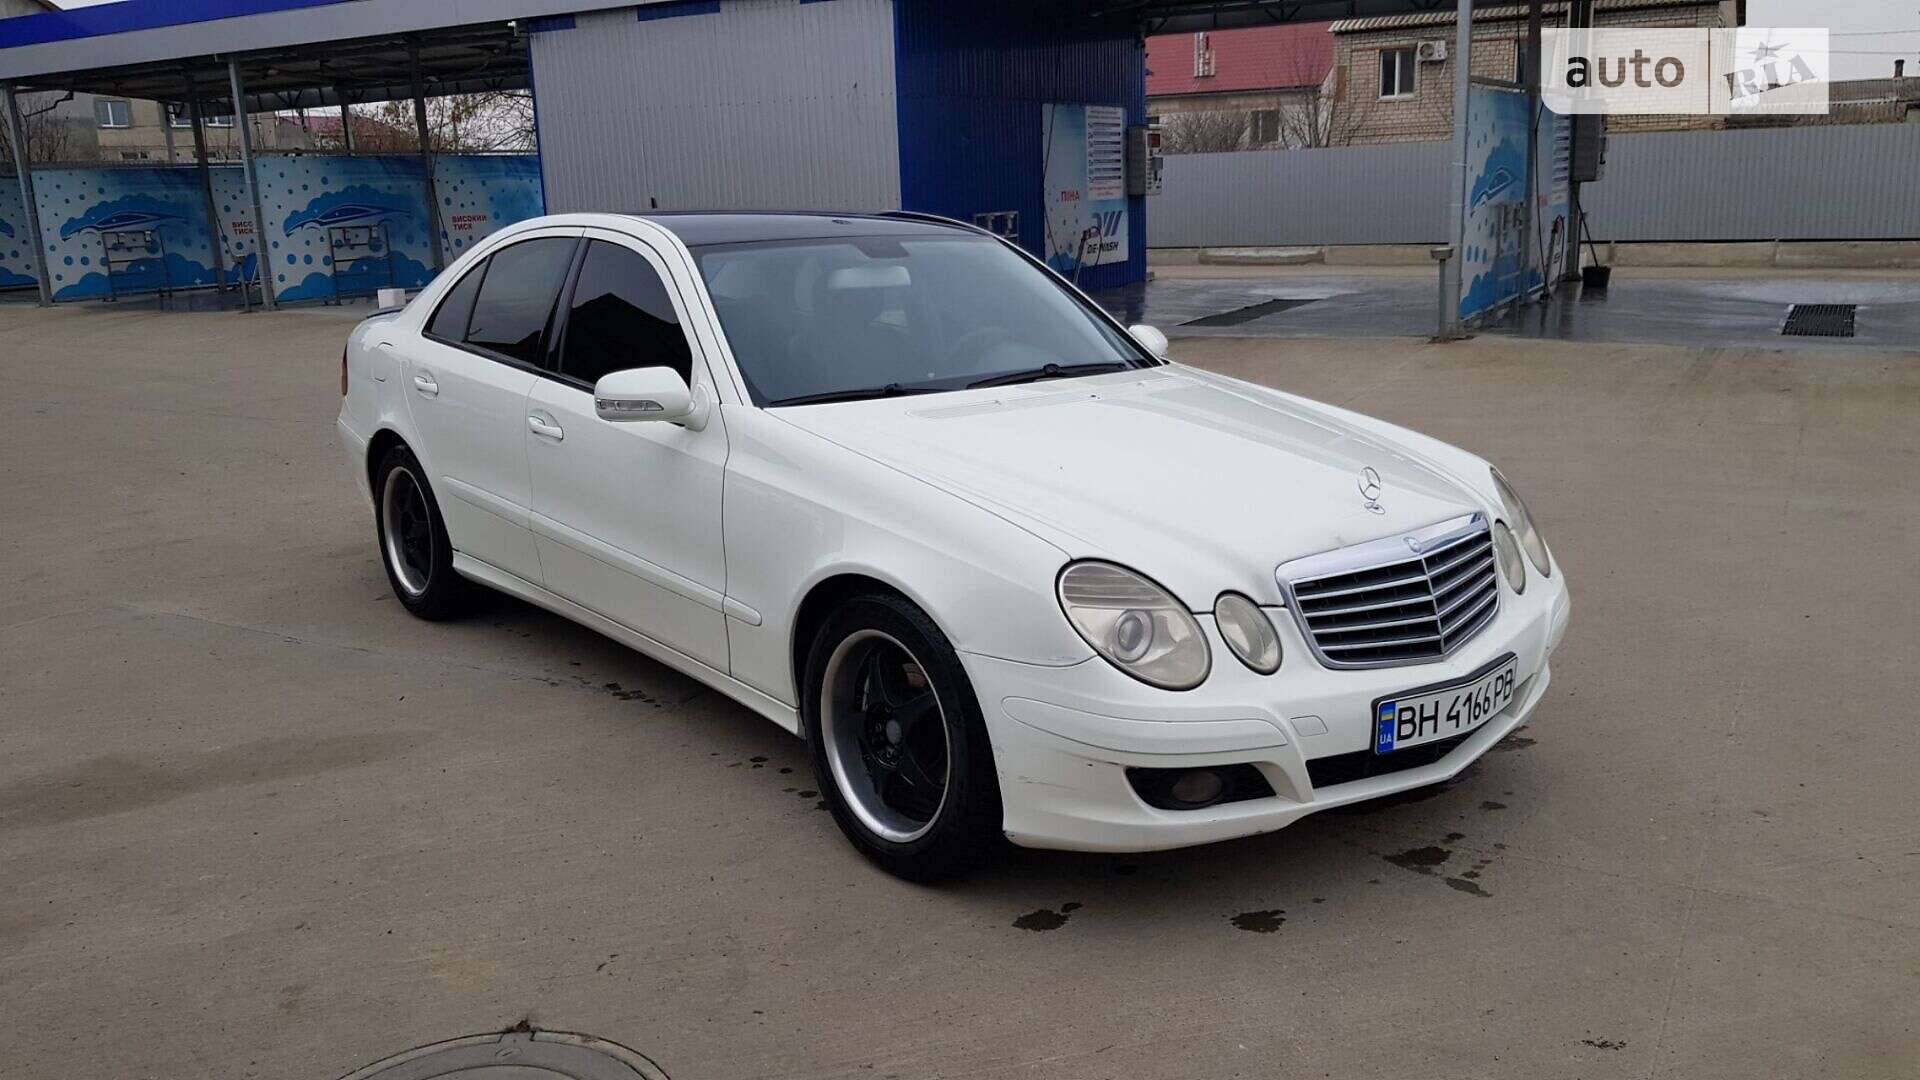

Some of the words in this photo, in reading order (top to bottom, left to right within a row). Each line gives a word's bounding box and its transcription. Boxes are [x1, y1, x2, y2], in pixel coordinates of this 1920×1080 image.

[1397, 700, 1439, 741] BH
[1446, 682, 1491, 728] 4166
[1379, 733, 1392, 744] UA
